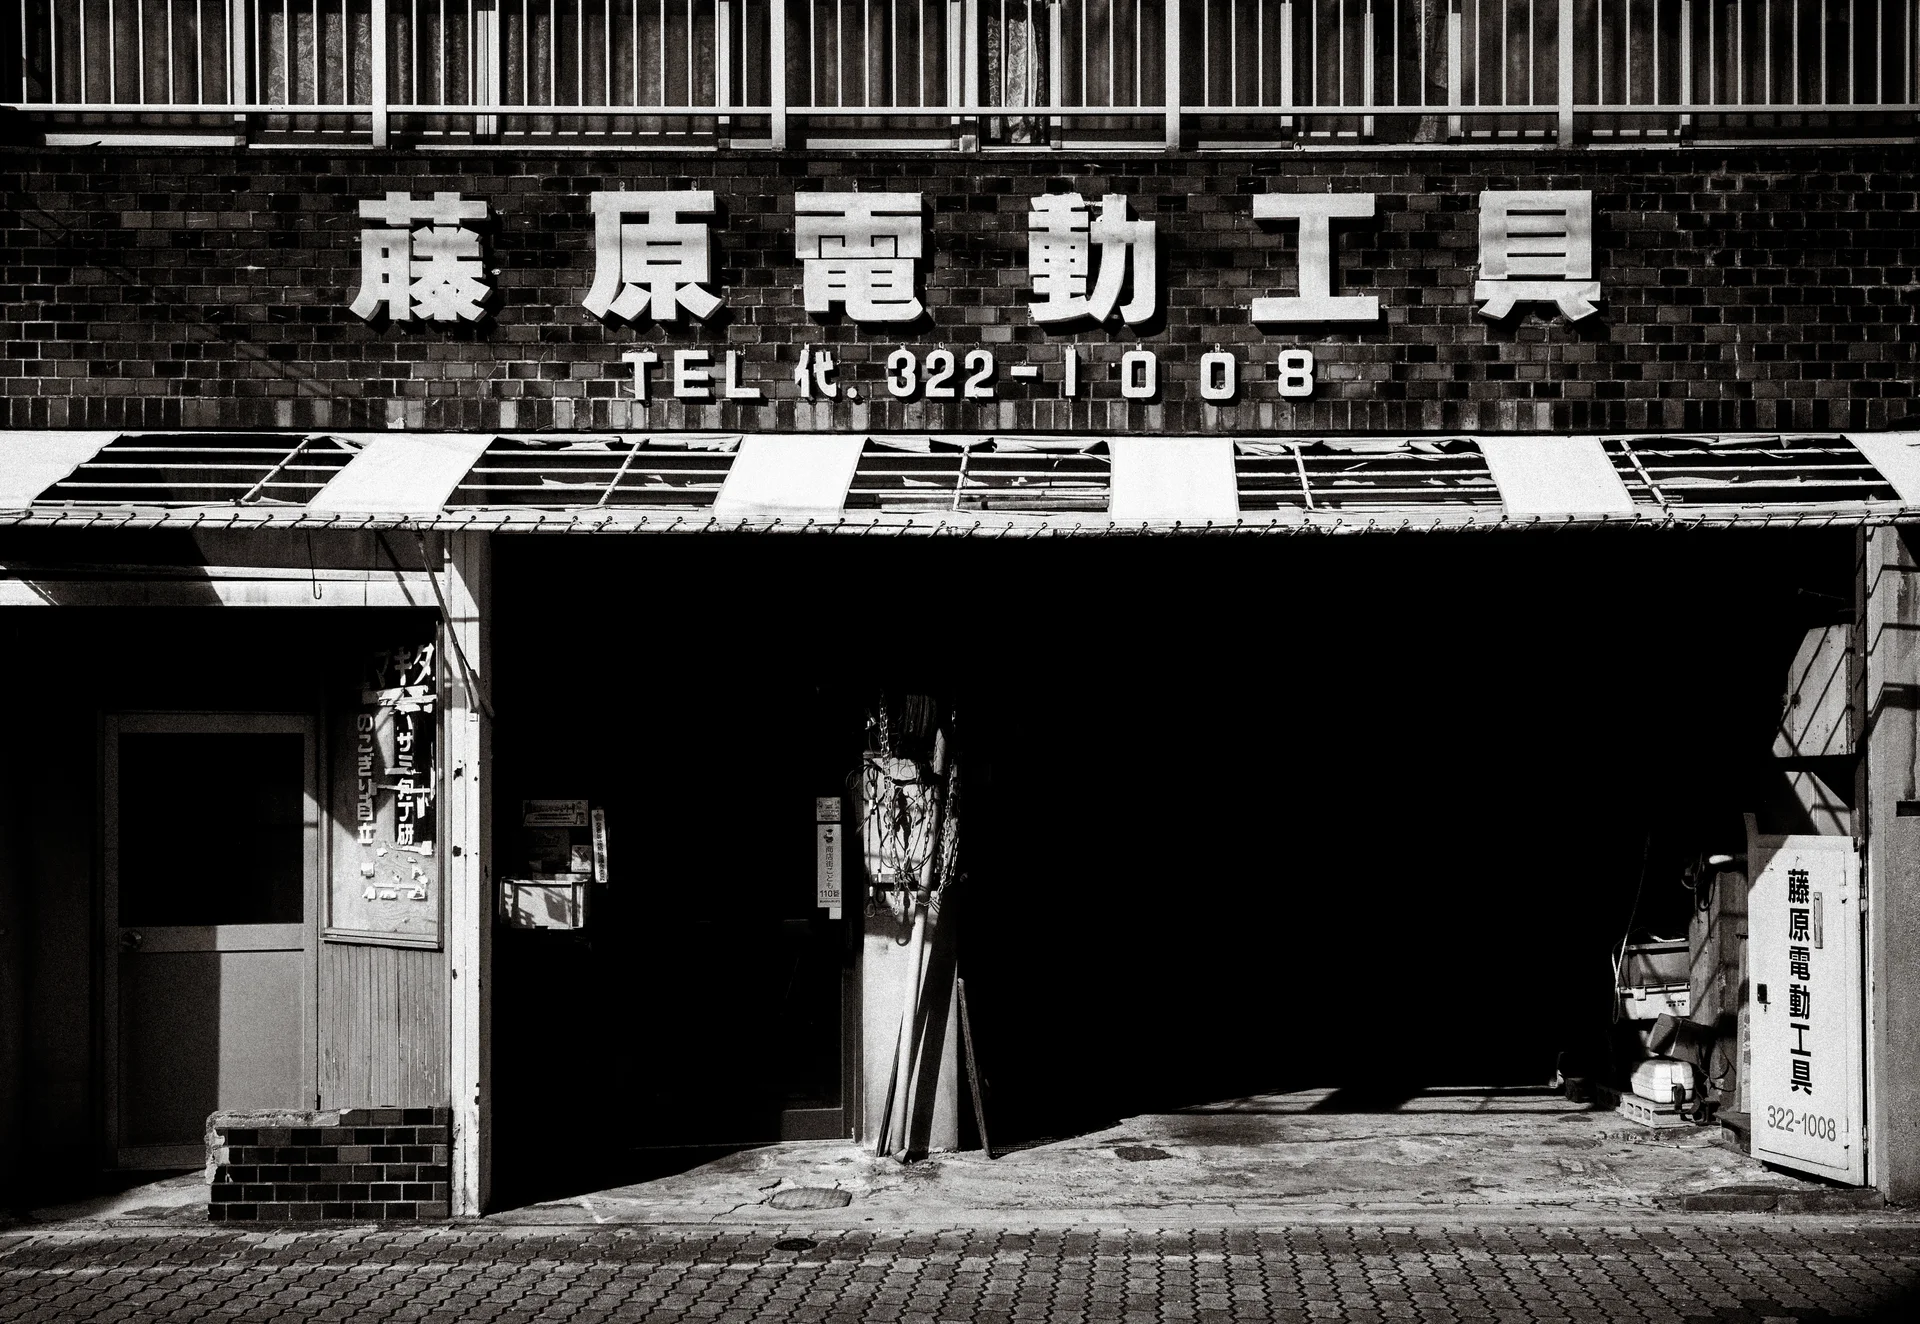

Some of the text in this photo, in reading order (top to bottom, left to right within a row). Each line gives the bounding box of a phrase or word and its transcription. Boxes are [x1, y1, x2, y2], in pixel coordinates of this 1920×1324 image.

[349, 190, 1602, 325] 藤原電動工具
[621, 350, 761, 402] TEL
[373, 643, 435, 688] マキタ
[1787, 869, 1813, 1096] 藤原電動工具
[1767, 1105, 1837, 1142] 322-1008
